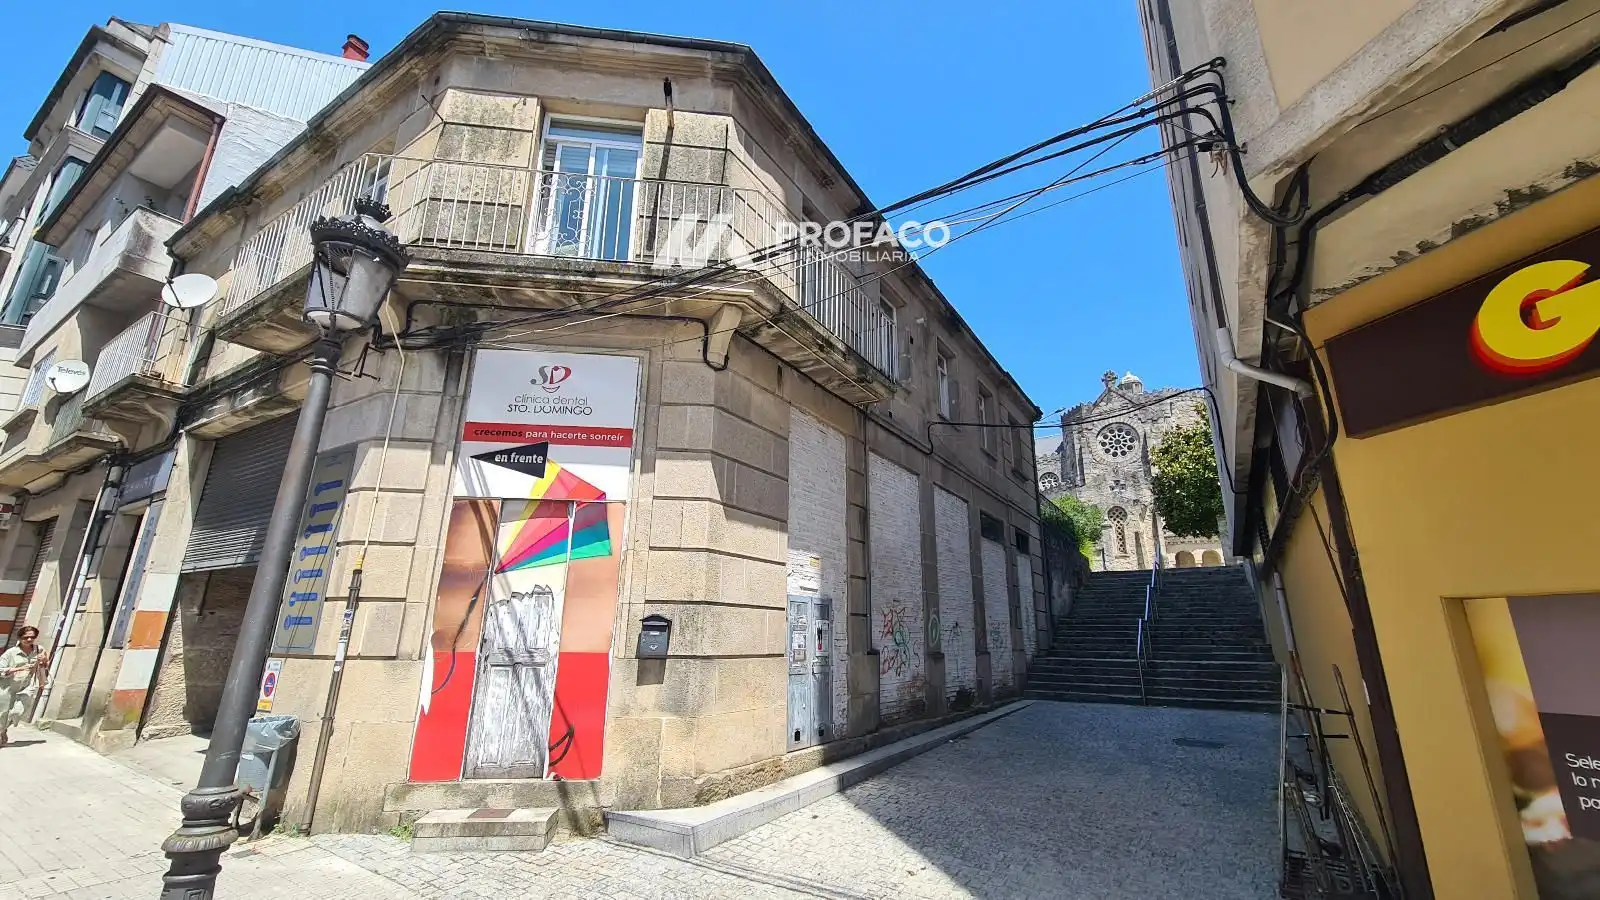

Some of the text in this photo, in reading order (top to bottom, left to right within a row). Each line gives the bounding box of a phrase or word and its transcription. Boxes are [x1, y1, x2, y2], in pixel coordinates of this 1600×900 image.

[1472, 260, 1600, 372] G
[514, 393, 588, 405] clínica dental
[507, 404, 593, 416] STO. DOMINGO
[474, 428, 624, 441] crecemos para hacerte sonreír
[494, 452, 544, 464] en frente
[1571, 771, 1588, 787] lo
